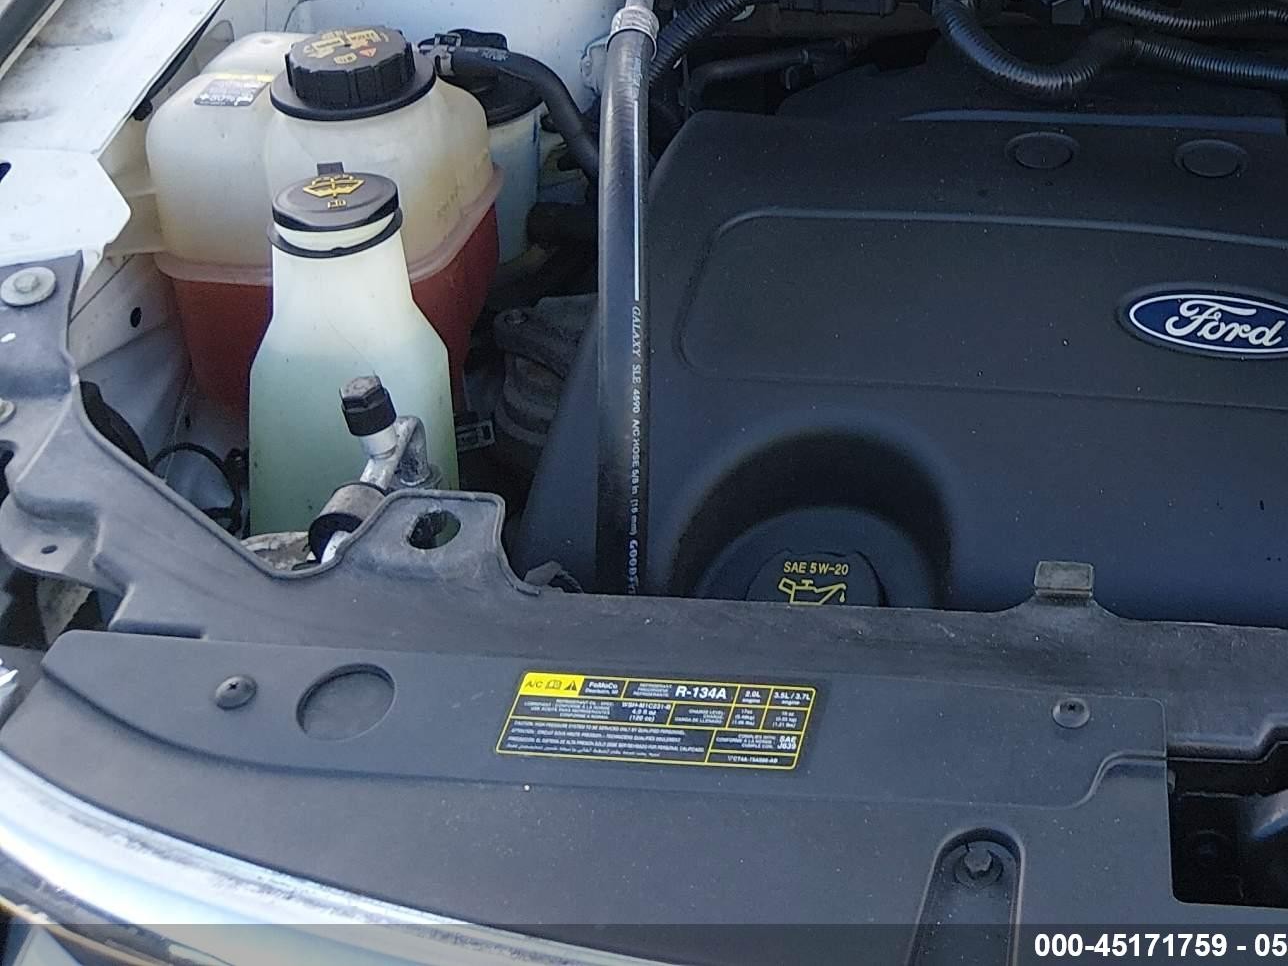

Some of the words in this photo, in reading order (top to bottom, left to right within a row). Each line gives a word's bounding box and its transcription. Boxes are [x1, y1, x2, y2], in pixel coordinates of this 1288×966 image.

[1165, 300, 1286, 346] Ford
[632, 306, 642, 357] GALAXY
[632, 364, 642, 384] SLE
[783, 561, 806, 574] SAE
[810, 562, 849, 576] 5W-20
[525, 680, 543, 689] A/C
[675, 685, 727, 700] R-134A
[795, 693, 811, 701] 3.7L
